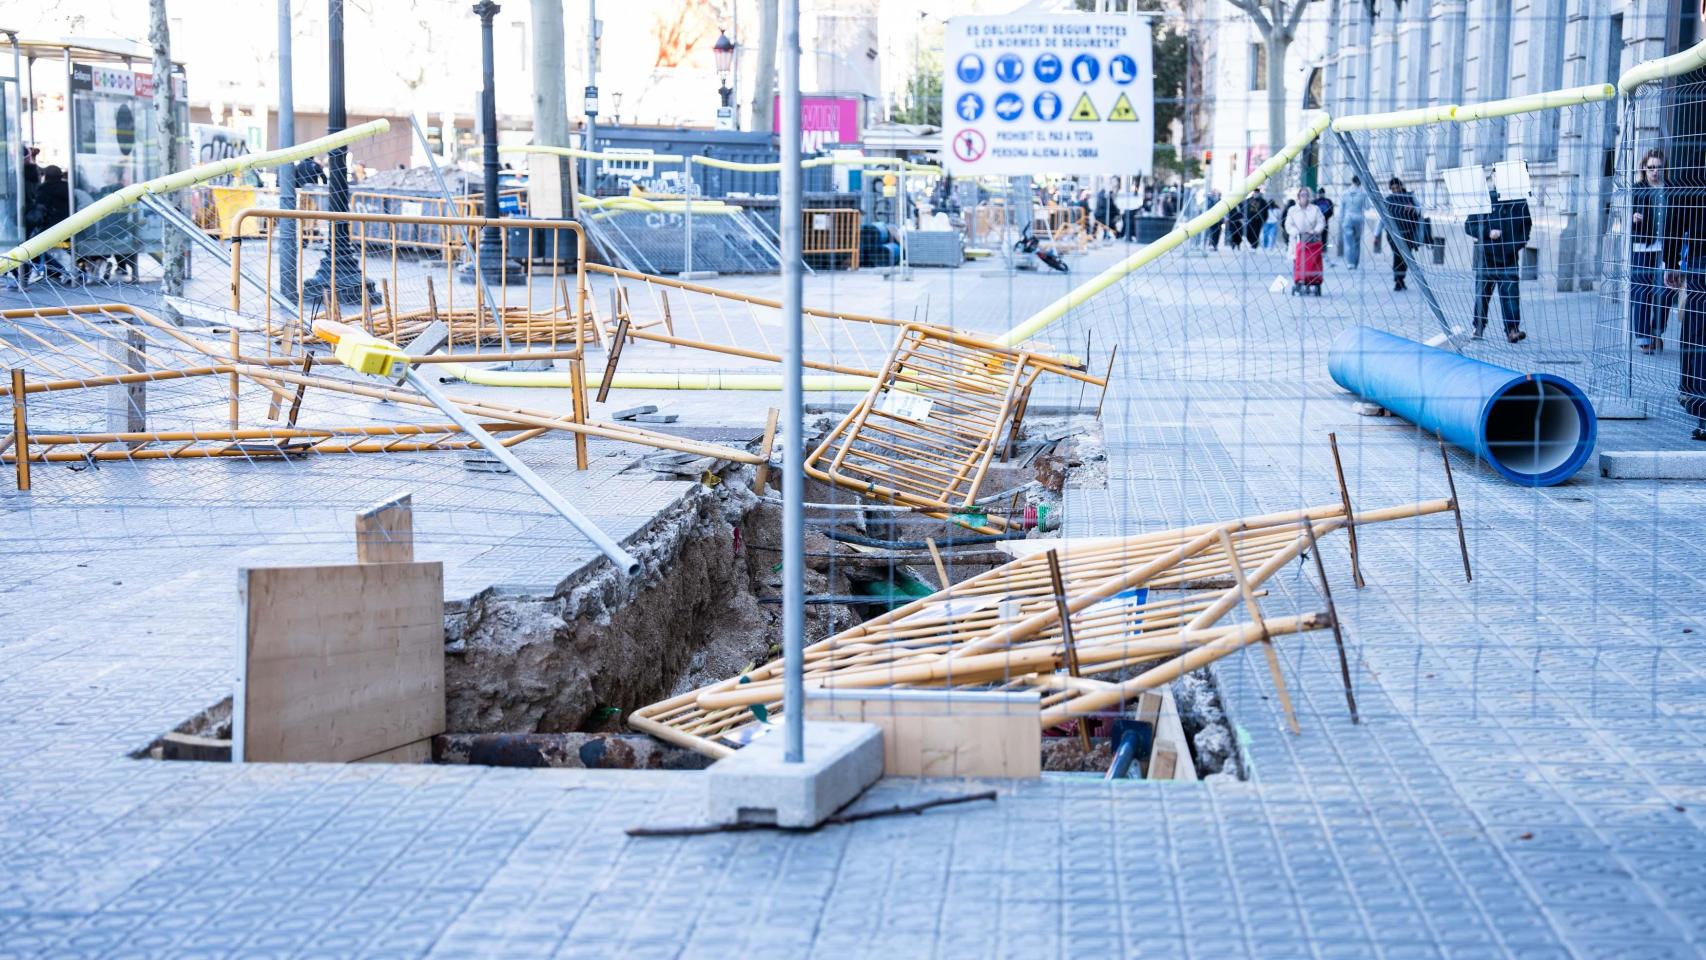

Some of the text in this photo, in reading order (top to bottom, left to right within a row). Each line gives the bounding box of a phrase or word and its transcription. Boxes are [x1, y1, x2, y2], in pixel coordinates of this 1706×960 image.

[967, 25, 1127, 36] ES OBLIGATORI SEGUIR TOTES
[975, 37, 1120, 48] LES NORMES DE SEGURETAT
[996, 131, 1093, 141] PROHIBIT EL PAS A TOTA
[992, 147, 1028, 157] PERSONA
[1032, 147, 1060, 157] ALIENA
[1063, 147, 1068, 157] A
